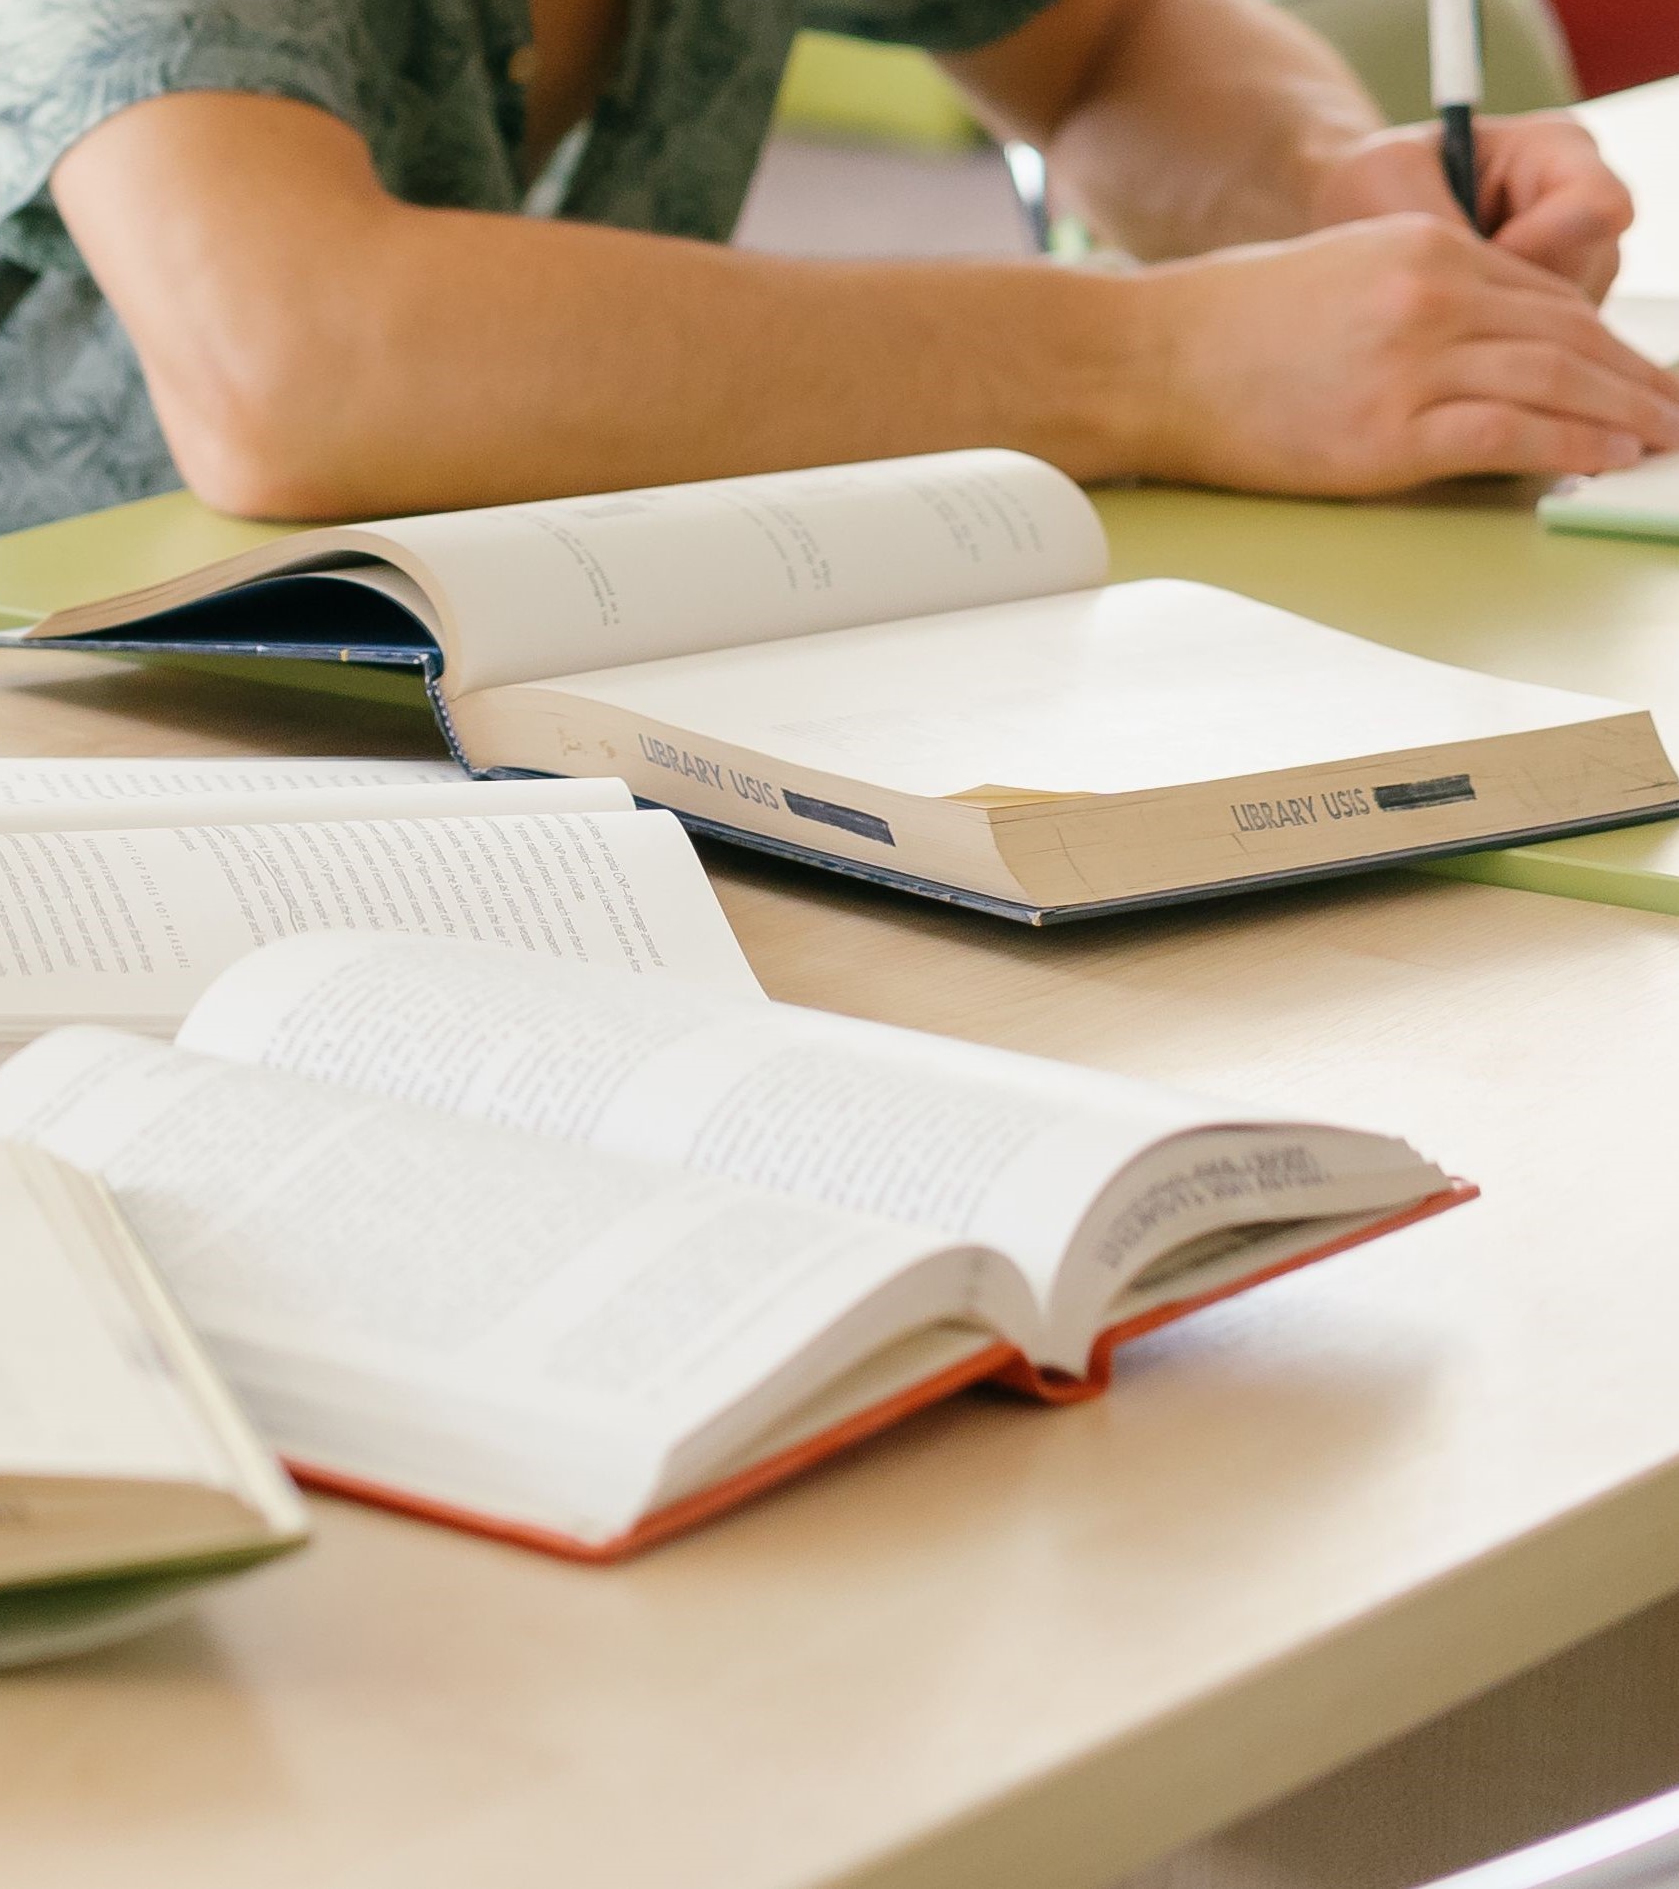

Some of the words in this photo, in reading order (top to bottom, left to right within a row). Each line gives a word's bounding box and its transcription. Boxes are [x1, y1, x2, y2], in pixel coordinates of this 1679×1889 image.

[639, 733, 724, 791] LIBRARY
[729, 769, 779, 810] USIS
[1231, 795, 1318, 831] LIBRARY
[1321, 787, 1370, 820] USIS
